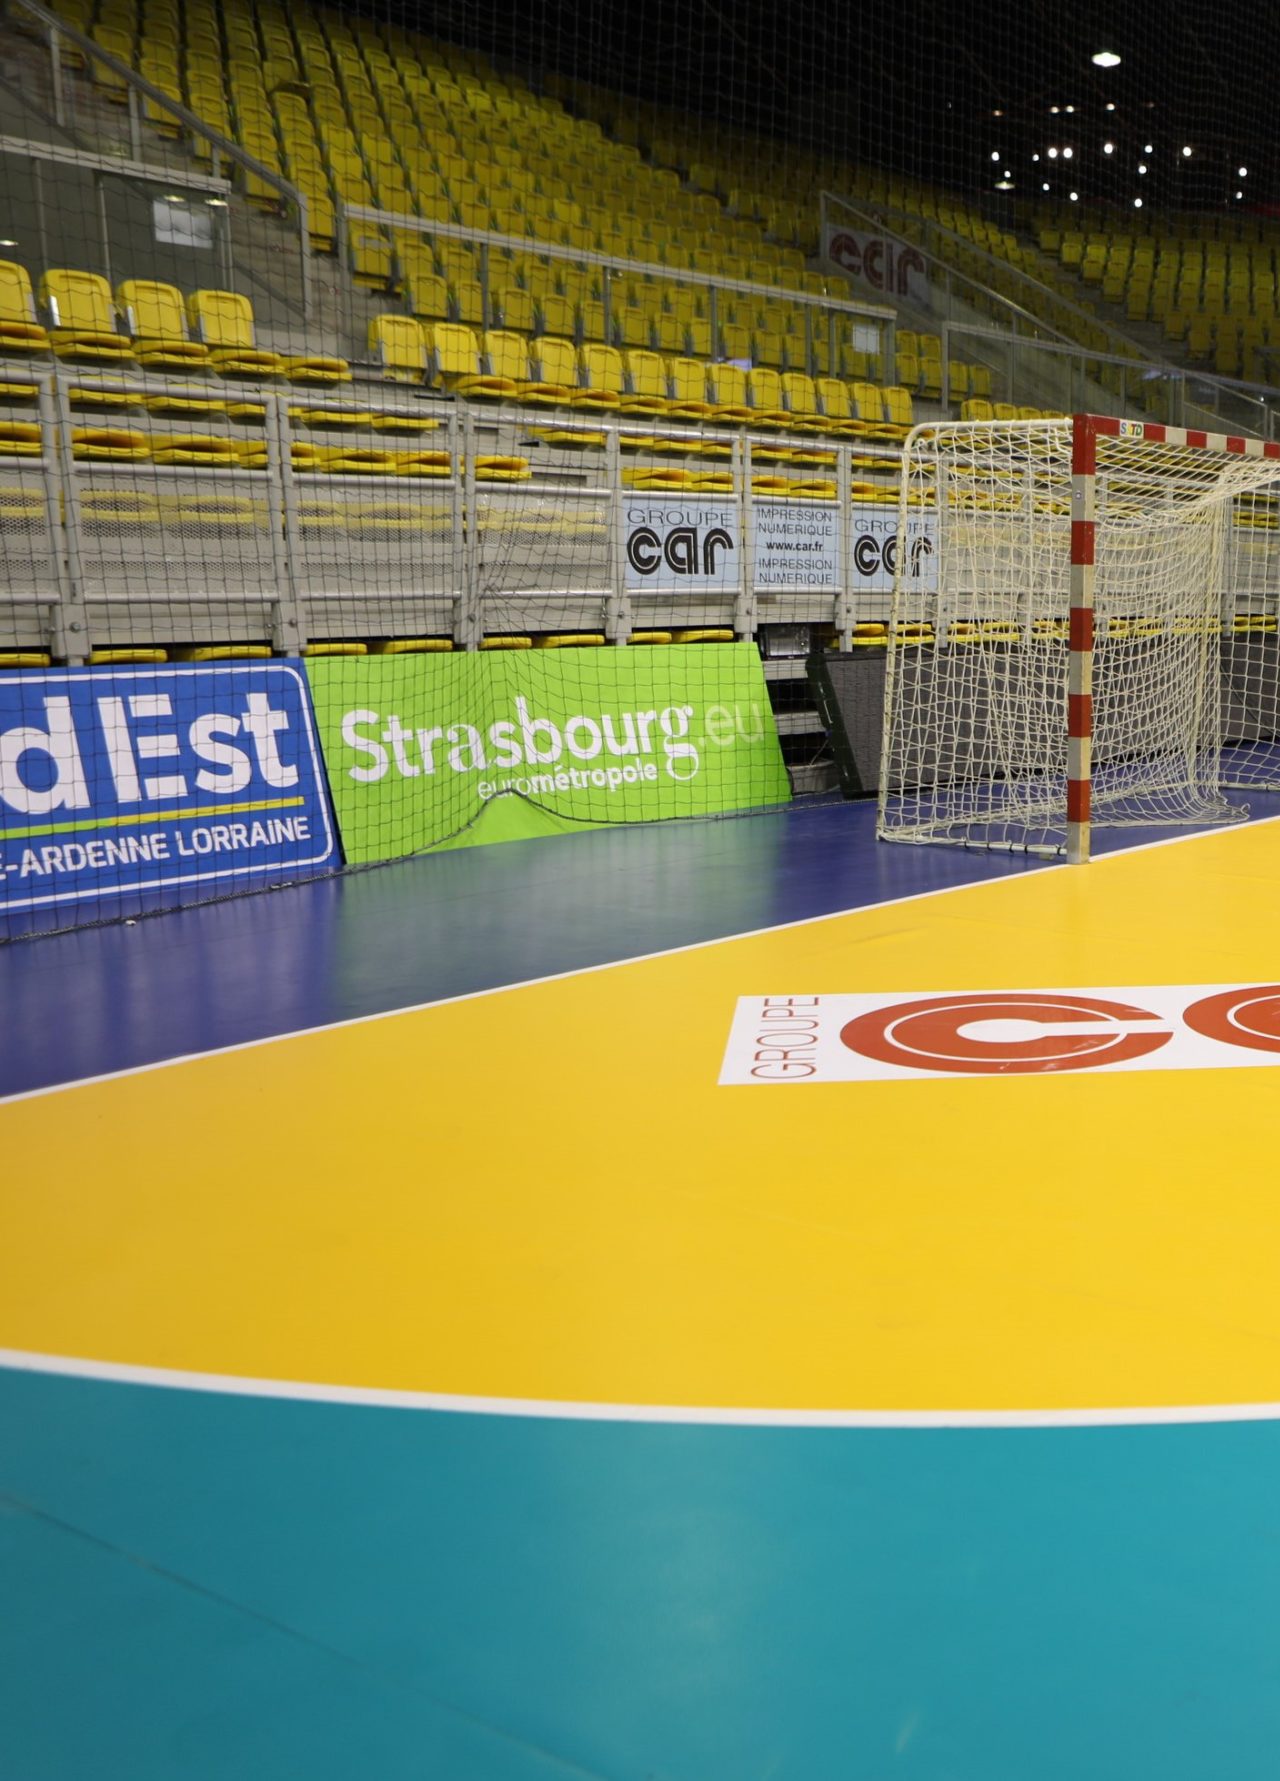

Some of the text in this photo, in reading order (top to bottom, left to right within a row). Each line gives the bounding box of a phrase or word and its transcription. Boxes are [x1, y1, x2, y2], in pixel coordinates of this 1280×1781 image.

[627, 509, 734, 527] GROUPE
[757, 508, 832, 522] IMPRESSION
[758, 523, 833, 536] NUMERIQUE
[627, 527, 734, 575] car
[766, 541, 824, 552] www.car.fr
[758, 558, 833, 570] IMPRESSION
[759, 573, 833, 585] NUMERIQUE
[177, 817, 311, 857] LORRAINE
[750, 996, 820, 1080] GROUPE
